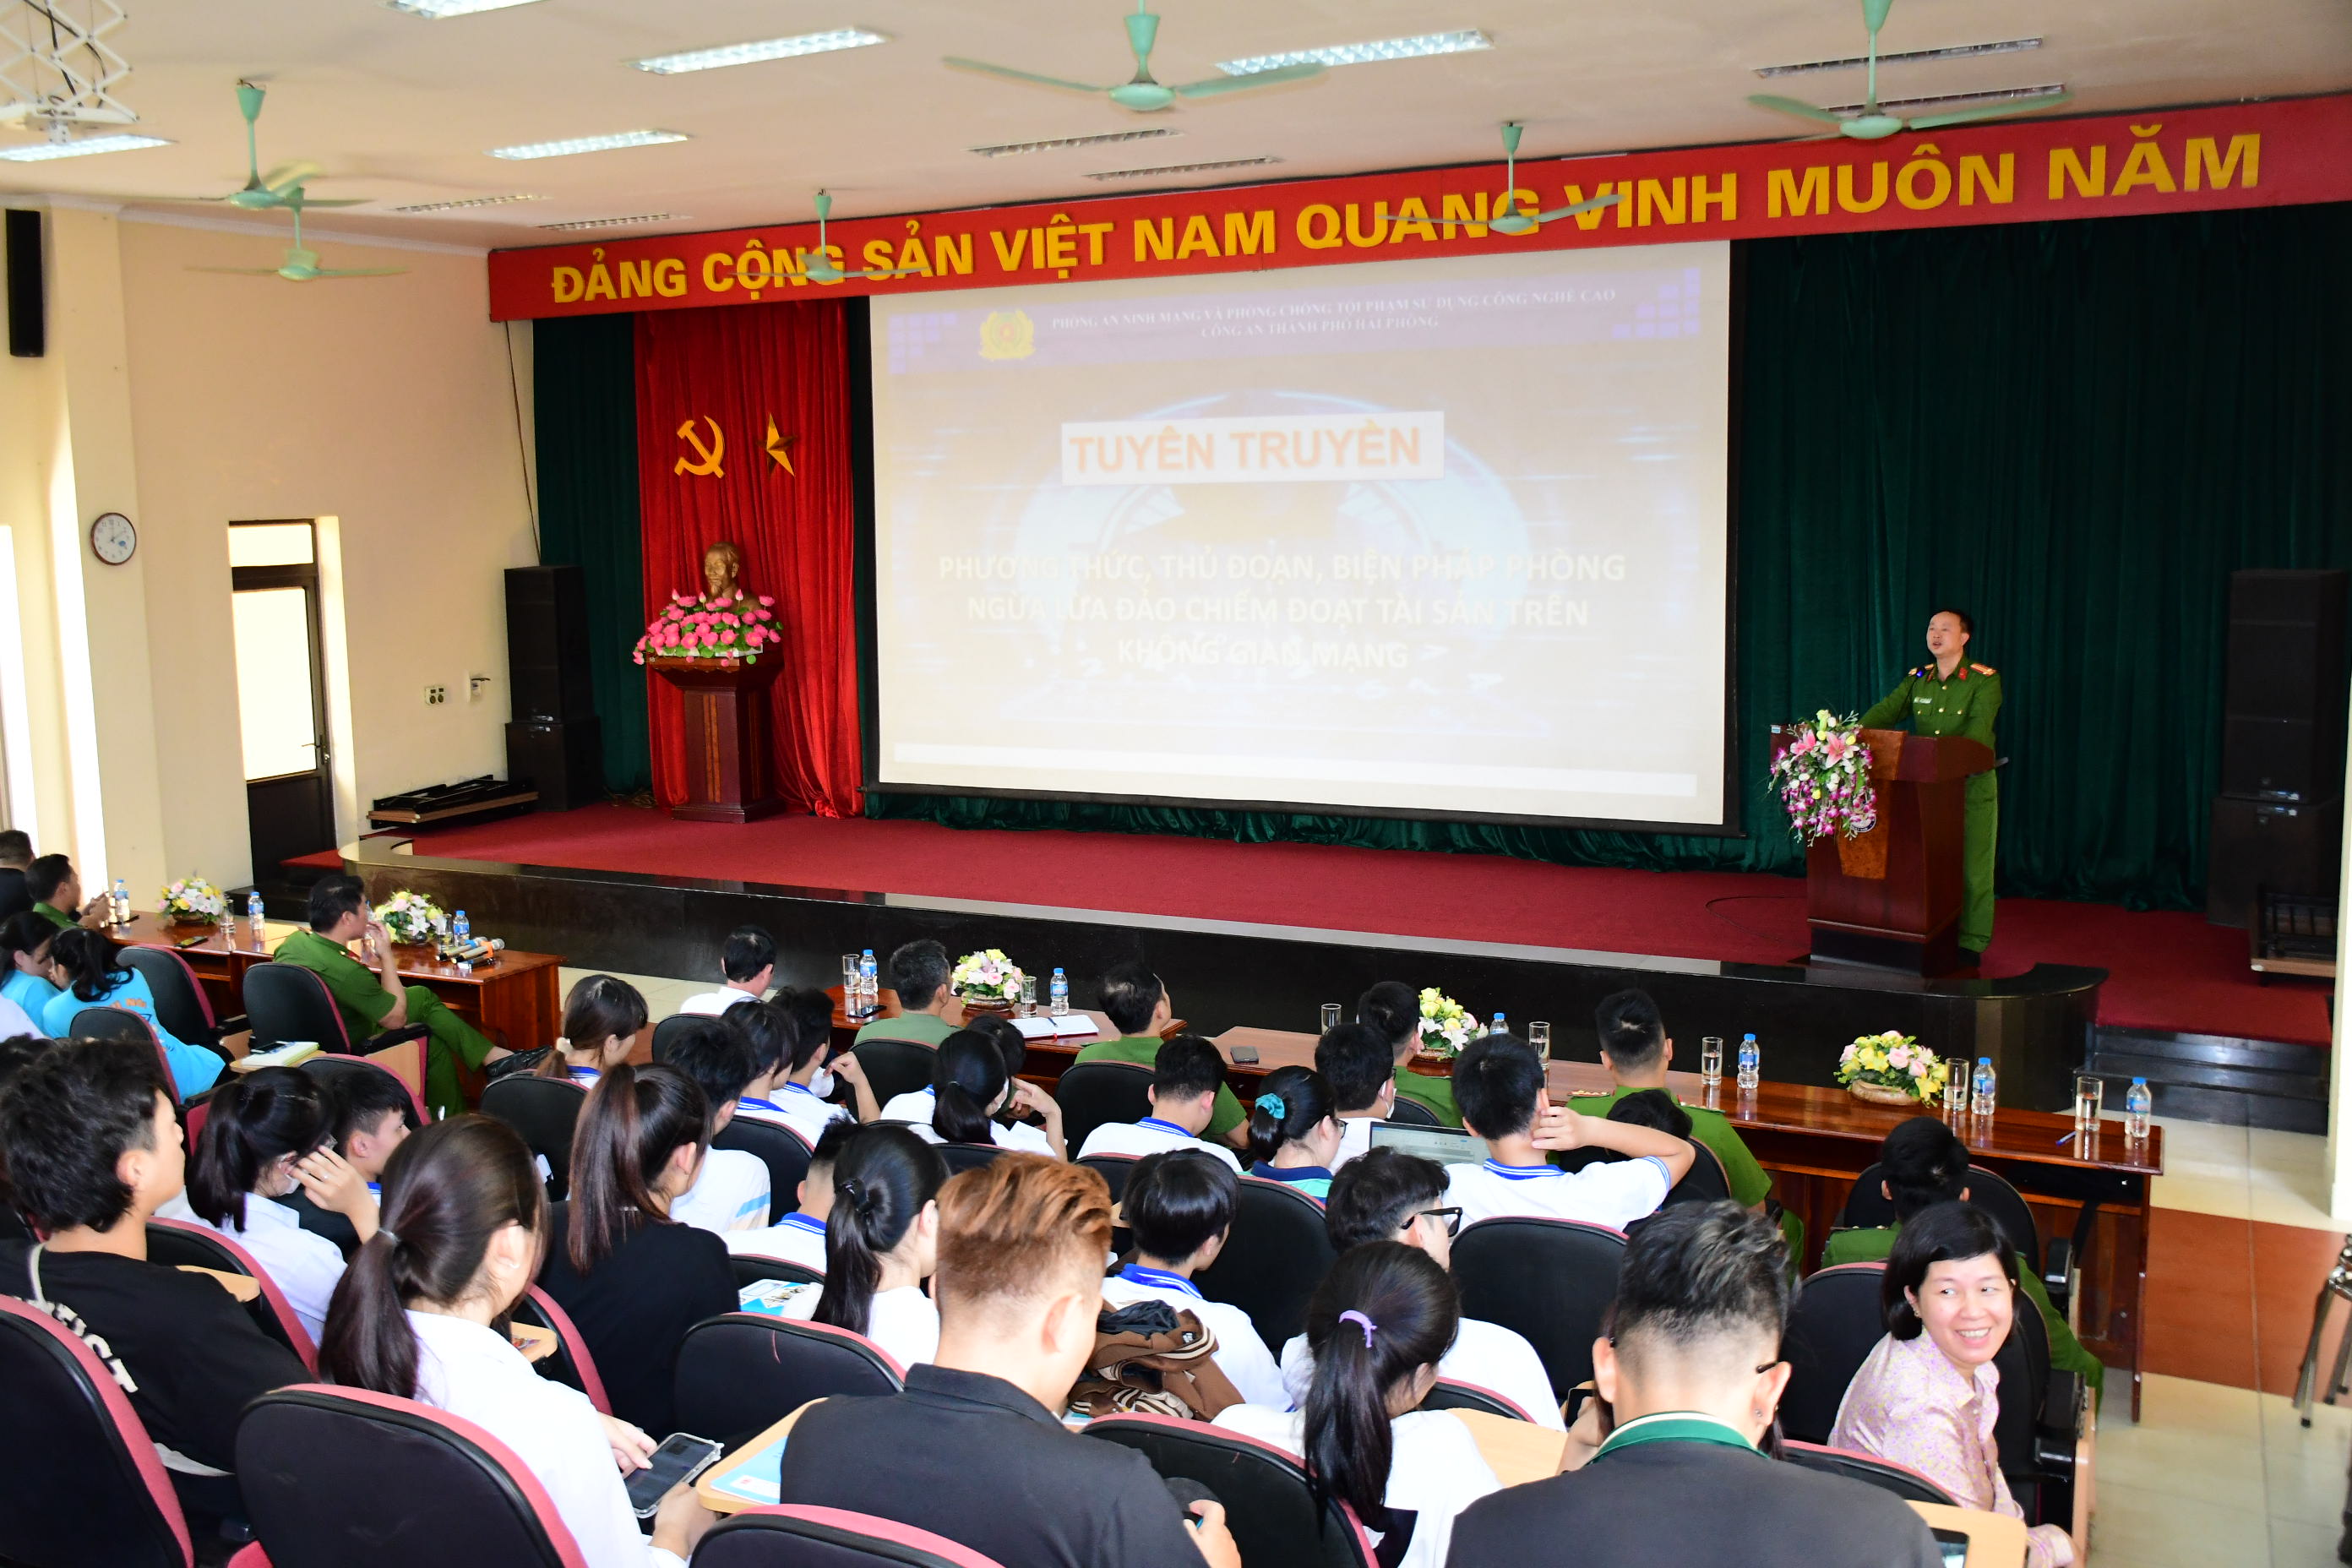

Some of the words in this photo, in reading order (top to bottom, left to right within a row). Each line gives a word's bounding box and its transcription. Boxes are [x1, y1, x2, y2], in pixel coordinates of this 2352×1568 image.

[551, 248, 687, 303] ĐẢNG
[702, 239, 845, 300] CỘNG
[863, 220, 973, 281] SẢN
[989, 214, 1113, 279] VIỆT
[1133, 210, 1274, 262] NAM
[1295, 188, 1540, 251] QUANG
[1564, 172, 1737, 231] VINH
[1767, 144, 2014, 218] MUÔN
[2048, 124, 2261, 200] NĂM
[1101, 314, 1119, 327] AN
[1122, 313, 1156, 325] NINH
[1580, 288, 1616, 302] CAO
[1246, 324, 1265, 337] AN
[1069, 425, 1214, 472] TUYÊN
[1229, 418, 1420, 468] TRUYỀN
[939, 553, 1059, 580] PHƯƠNG
[1068, 549, 1152, 585] THỨC,
[1160, 545, 1217, 580] THỦ
[1227, 553, 1323, 585] ĐOẠN,
[1333, 548, 1402, 585] BIỆN
[1412, 547, 1496, 580] PHÁP
[1506, 547, 1627, 580] PHÒNG
[1115, 587, 1176, 622] ĐẢO
[1184, 587, 1278, 623] CHIẾM
[1287, 596, 1368, 631] ĐOẠT
[1376, 592, 1422, 624] TÀI
[1432, 590, 1493, 625] SẢN
[1505, 595, 1588, 627] TRÊN
[1311, 640, 1408, 673] MẠNG
